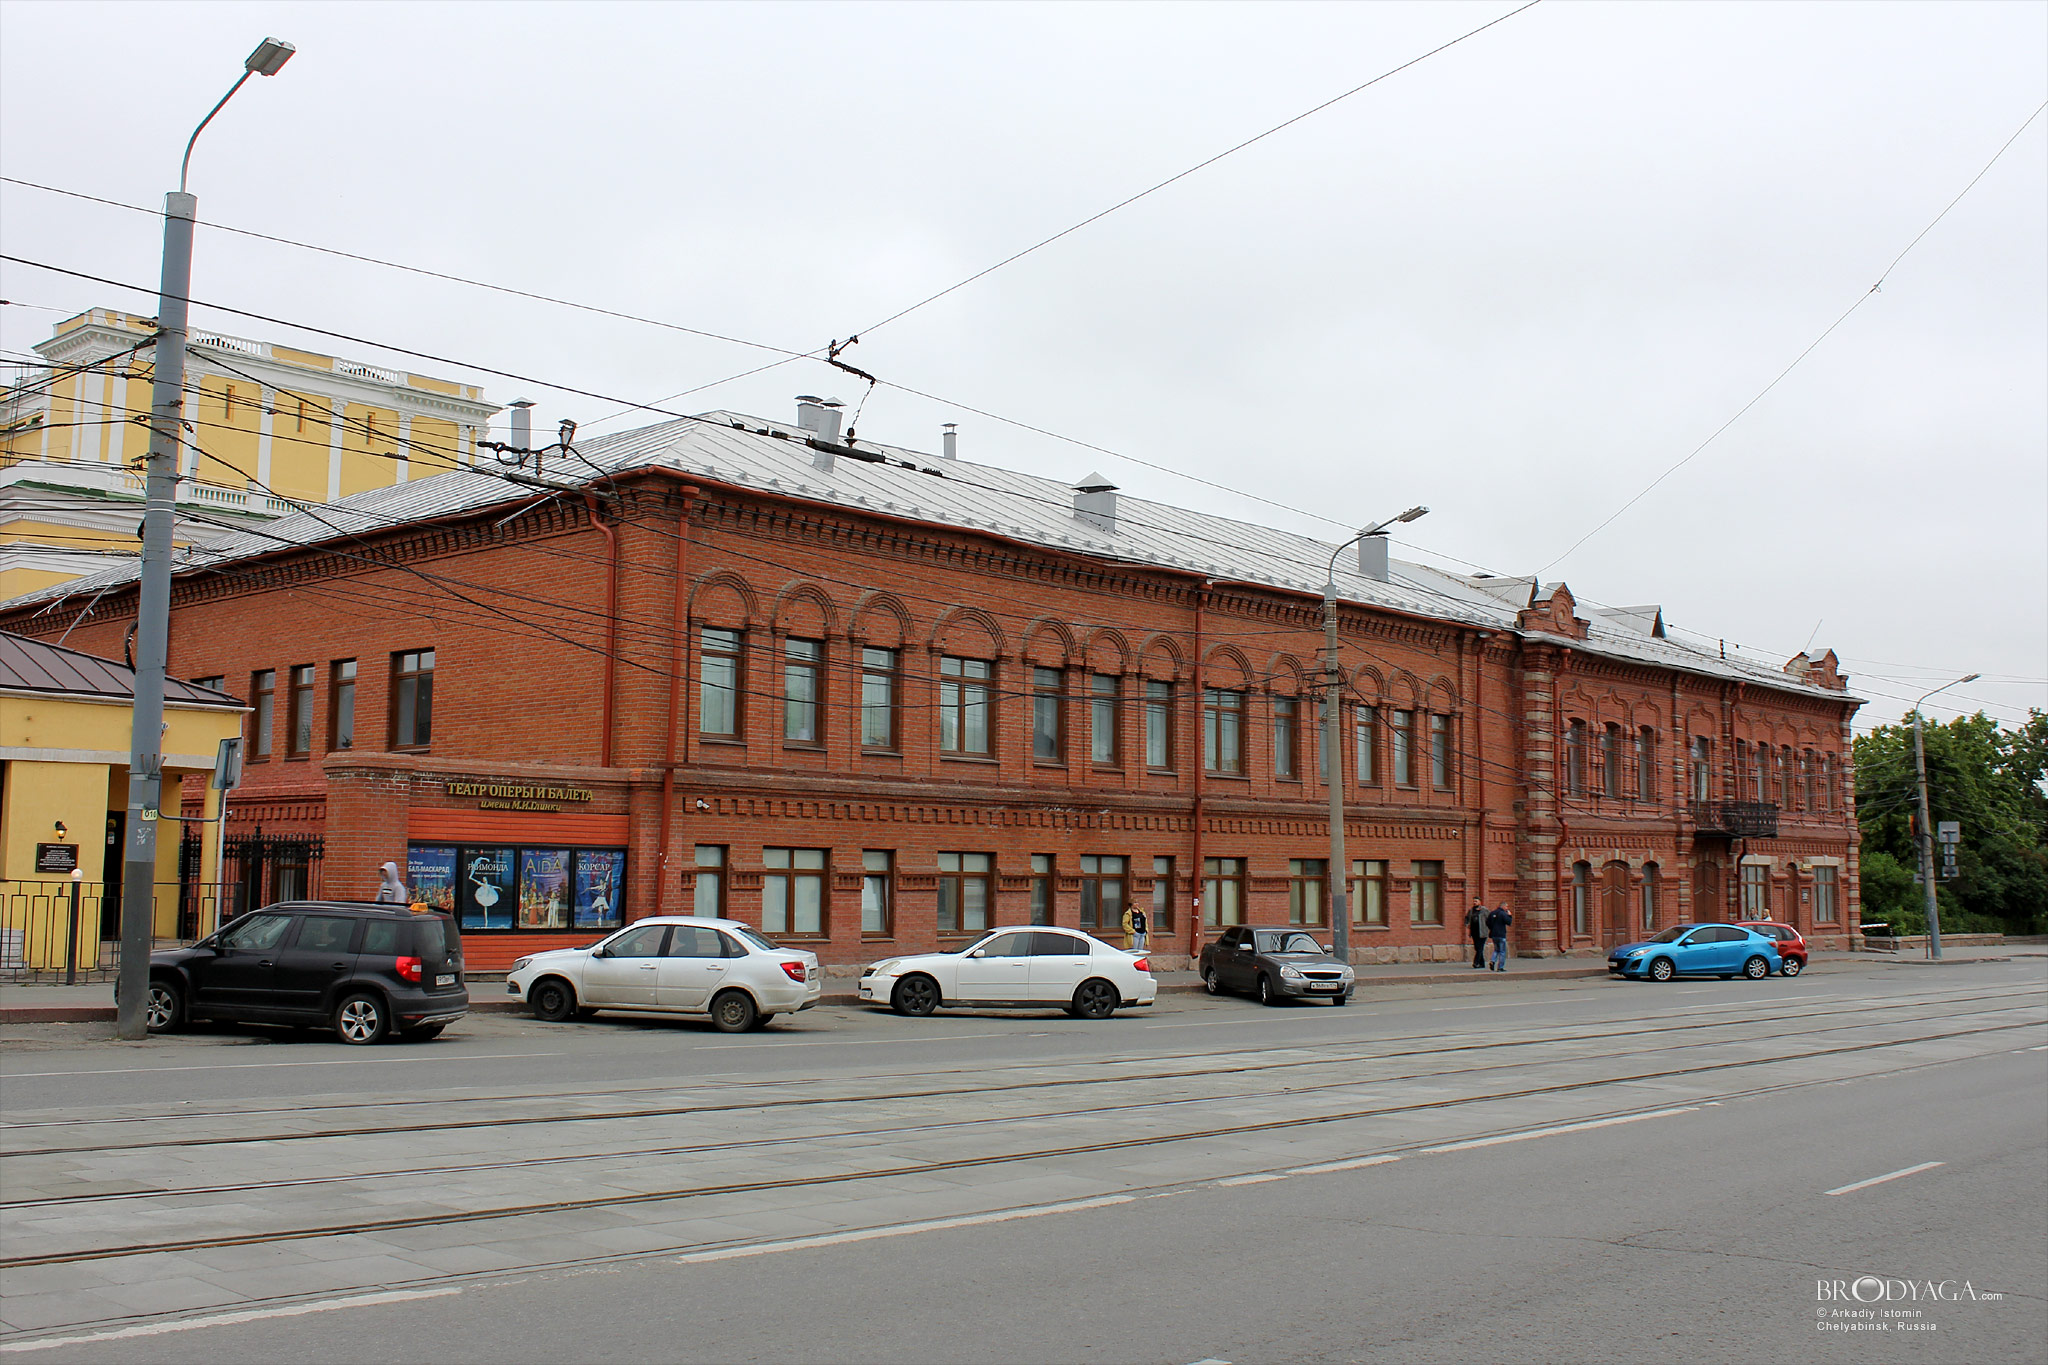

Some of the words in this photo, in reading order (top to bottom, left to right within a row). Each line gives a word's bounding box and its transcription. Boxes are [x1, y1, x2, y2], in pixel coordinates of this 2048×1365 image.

[447, 782, 487, 796] ТЕАТР
[489, 784, 534, 799] ОПЕРЫ
[536, 787, 546, 799] И
[547, 787, 594, 801] БАЛЕТА
[480, 800, 510, 809] имени
[408, 865, 450, 873] БАЛ-МАСКАРАД
[578, 863, 610, 871] КОРСАР
